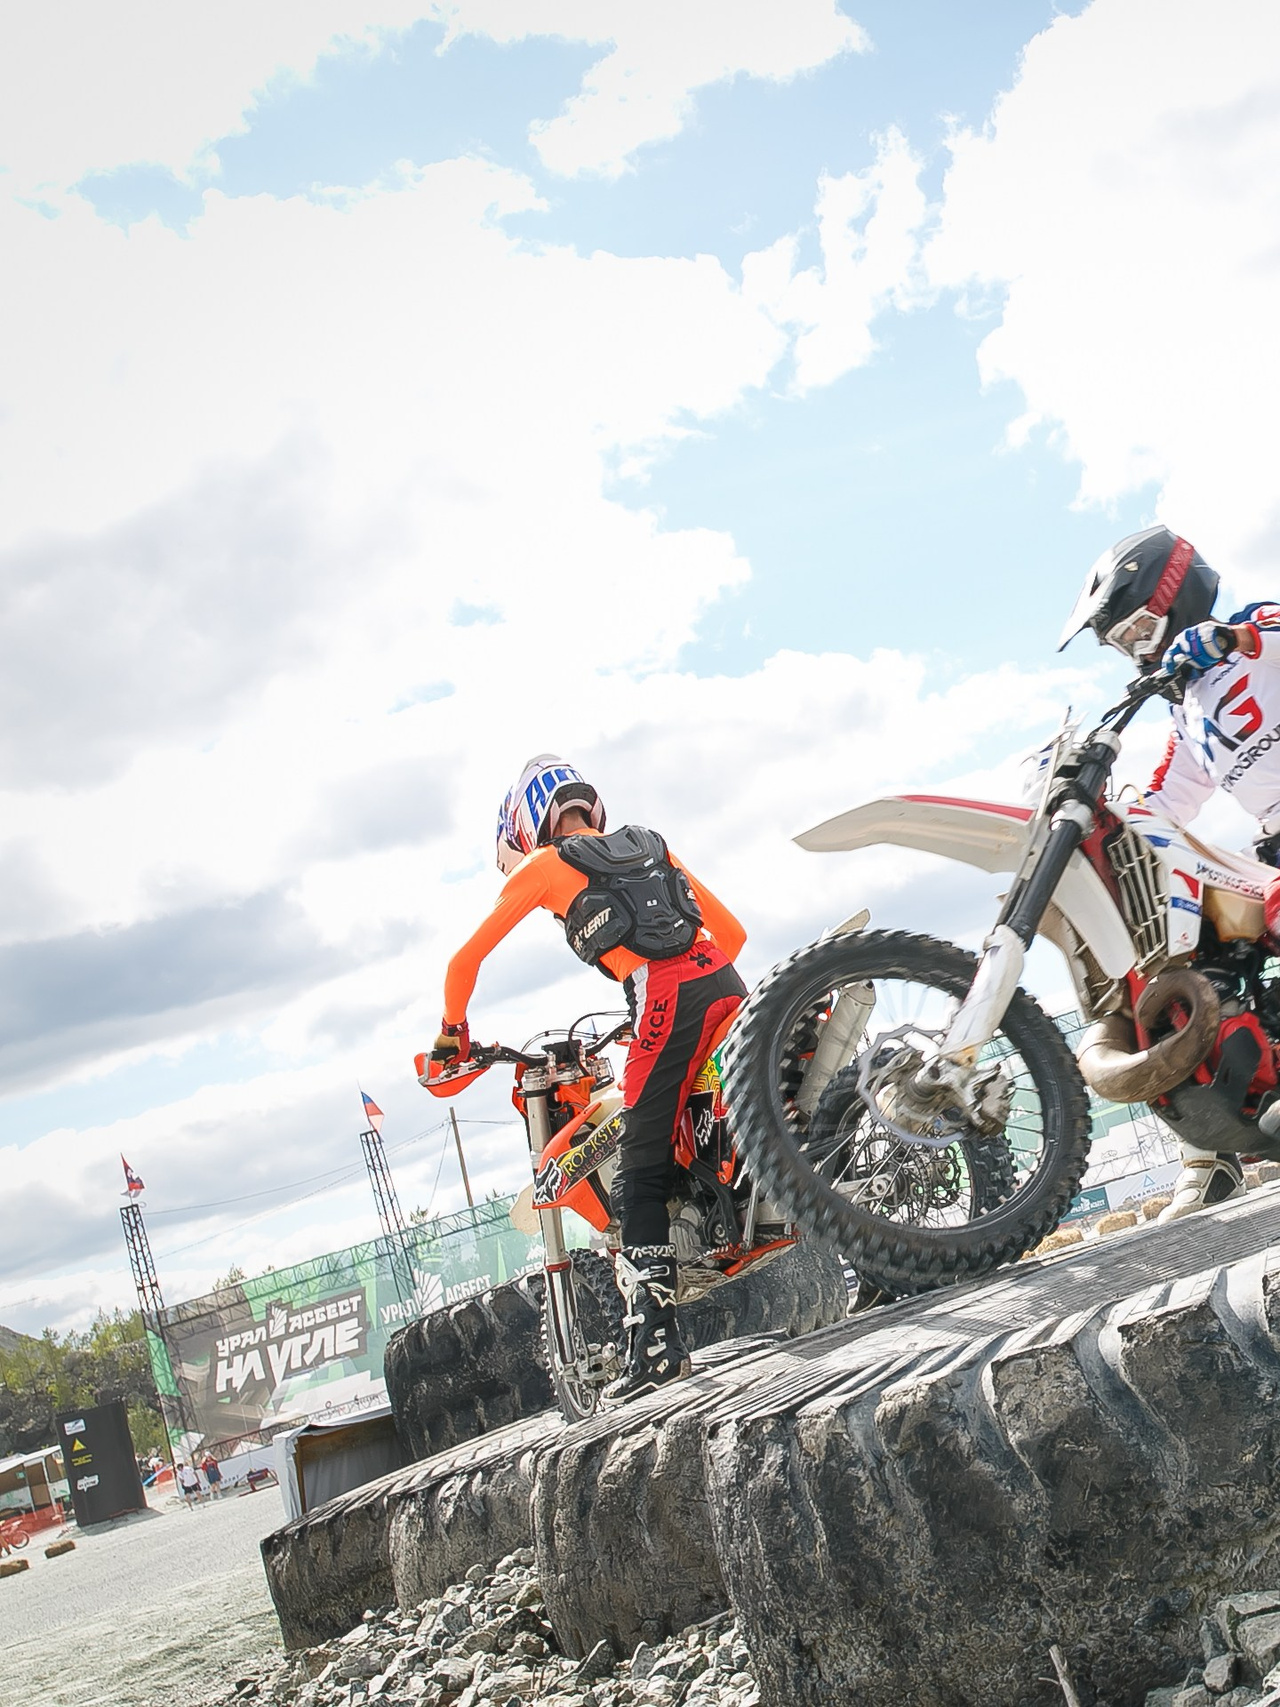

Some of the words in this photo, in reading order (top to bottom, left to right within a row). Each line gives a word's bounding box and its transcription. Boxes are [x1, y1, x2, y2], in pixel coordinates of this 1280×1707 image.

[216, 1326, 267, 1357] УРАЛ
[288, 1294, 362, 1334] АСБЕСТ
[380, 1298, 421, 1325] УРАЛ
[215, 1349, 266, 1393] НА
[266, 1317, 363, 1389] УГЛЕ
